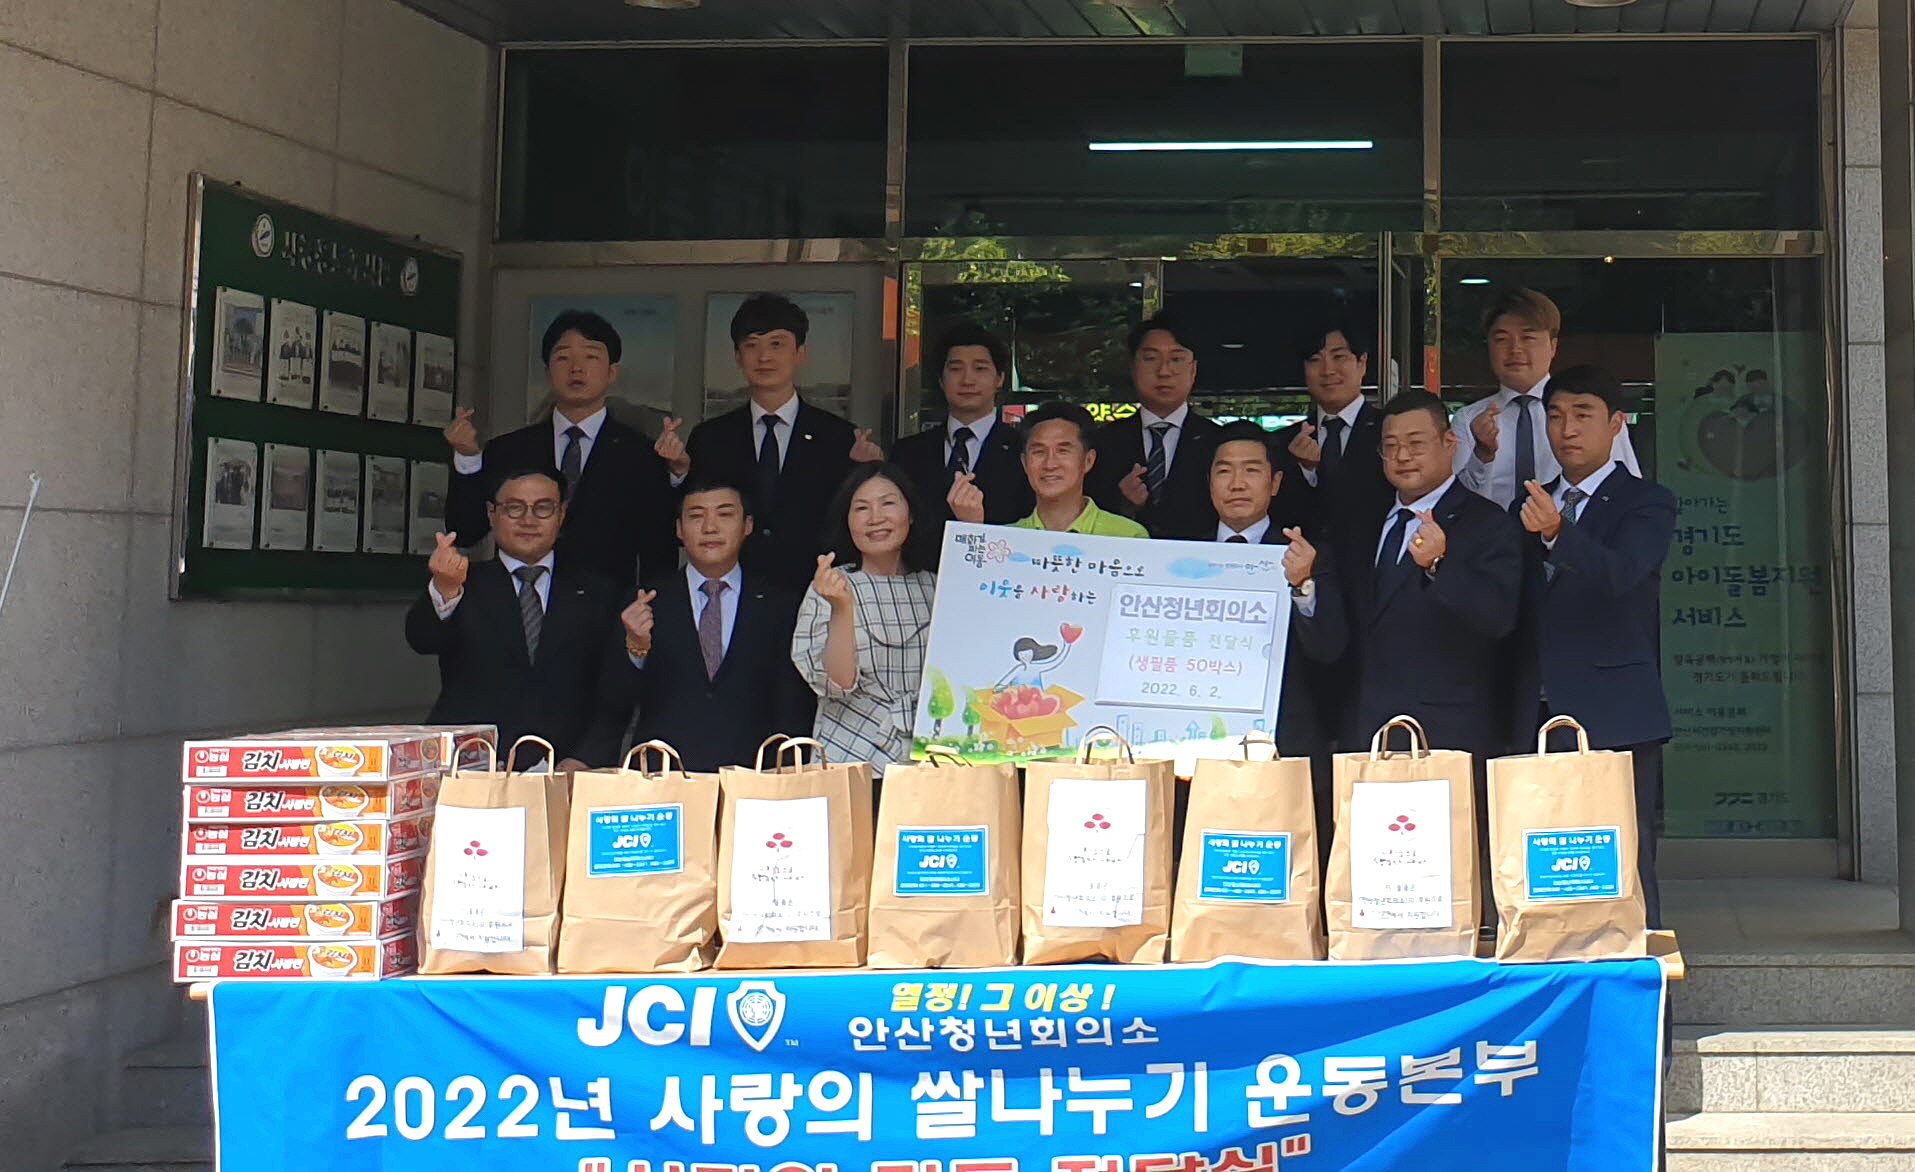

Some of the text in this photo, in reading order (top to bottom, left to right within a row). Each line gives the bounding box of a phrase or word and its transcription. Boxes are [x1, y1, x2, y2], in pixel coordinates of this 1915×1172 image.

[1674, 525, 1744, 557] 경기도
[1031, 556, 1145, 578] 따뜻한 마음으로
[979, 579, 1097, 605] 이웃을 사랑하는
[1673, 607, 1746, 628] 서비스
[1126, 627, 1253, 650] 후원물품 전달식
[1128, 655, 1242, 677] (생필품 50박스)
[1141, 682, 1181, 696] 2022.
[1189, 686, 1201, 698] 6.
[241, 750, 282, 772] 김치
[244, 790, 286, 812] 김치
[241, 827, 282, 849] 김치
[612, 834, 639, 849] JCI
[919, 855, 945, 869] JCI
[1222, 860, 1248, 874] JCI
[1551, 857, 1579, 872] JCI
[240, 868, 281, 891] 김치
[231, 907, 272, 930] 김치
[233, 949, 275, 972] 김치
[890, 983, 973, 1012] 열정!
[979, 984, 1014, 1011] 그
[577, 985, 717, 1047] JCI
[848, 1016, 1160, 1052] 안산청년회의소
[345, 1039, 1540, 1147] 2022년 사랑의 쌀나누기 운동본부
